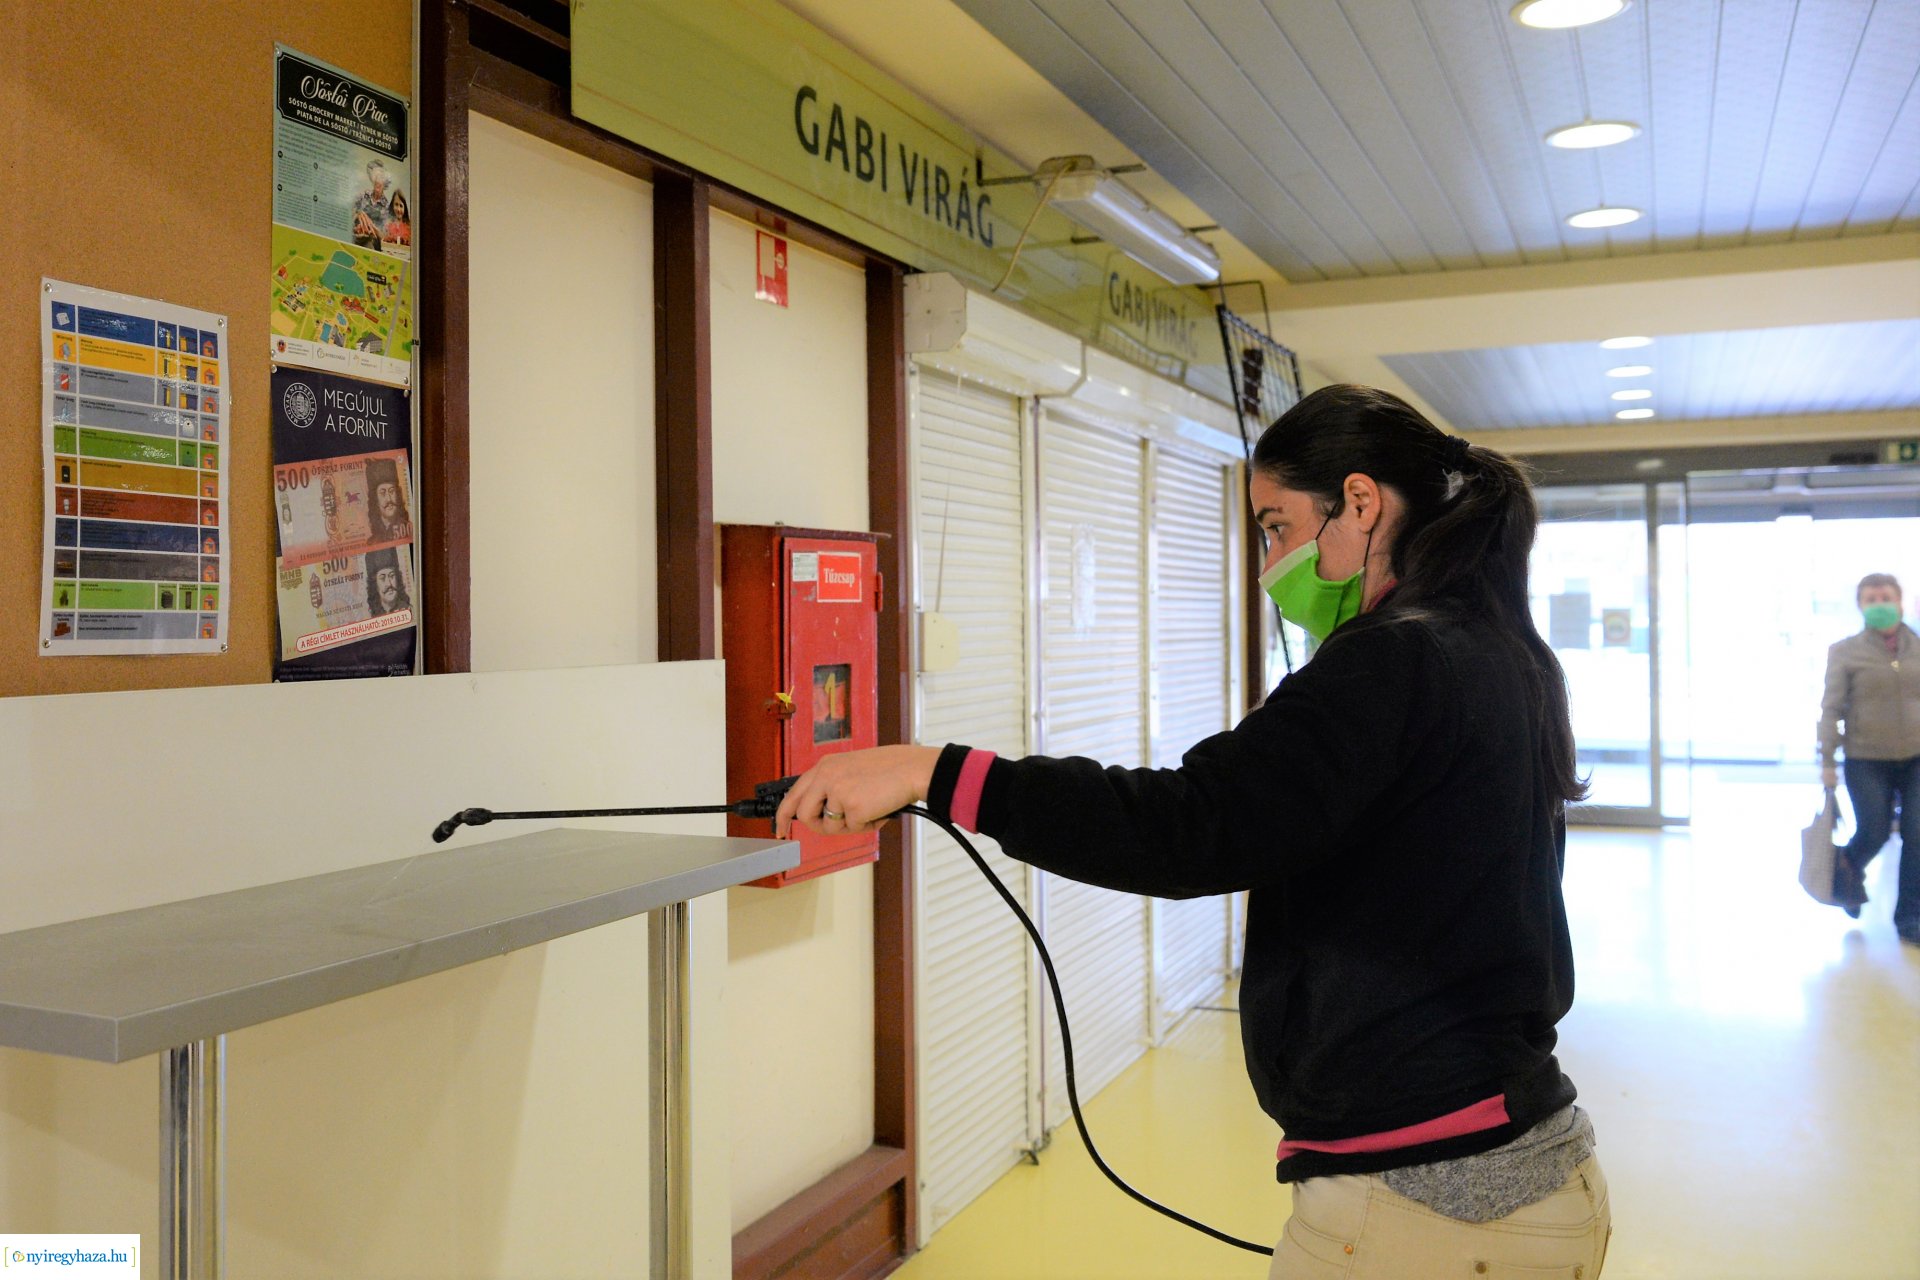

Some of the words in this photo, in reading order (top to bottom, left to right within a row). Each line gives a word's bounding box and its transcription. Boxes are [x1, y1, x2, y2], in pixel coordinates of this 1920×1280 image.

[288, 97, 308, 109] SÓSTÓ
[308, 104, 334, 119] GROCERY
[335, 114, 356, 128] MARKET
[382, 132, 399, 145] SÓSTÓ
[352, 94, 389, 124] Piac
[314, 115, 322, 124] DE
[322, 118, 330, 127] LA
[330, 121, 349, 135] SÓSTÓ
[375, 138, 392, 151] SÓSTÓ
[794, 85, 887, 192] GABI
[899, 143, 993, 248] VIRÁG
[1108, 271, 1150, 333] GABI
[324, 388, 388, 418] MEGÚJUL
[324, 413, 336, 433] A
[339, 415, 389, 440] FORINT
[276, 466, 310, 492] 500
[340, 460, 364, 472] FORINT
[322, 556, 349, 575] 500
[823, 567, 855, 588] Tűzcsap
[300, 640, 306, 649] A
[306, 635, 320, 648] RÉGI
[320, 630, 340, 643] CÍMLET
[340, 620, 380, 639] HASZNÁLHATÓ:
